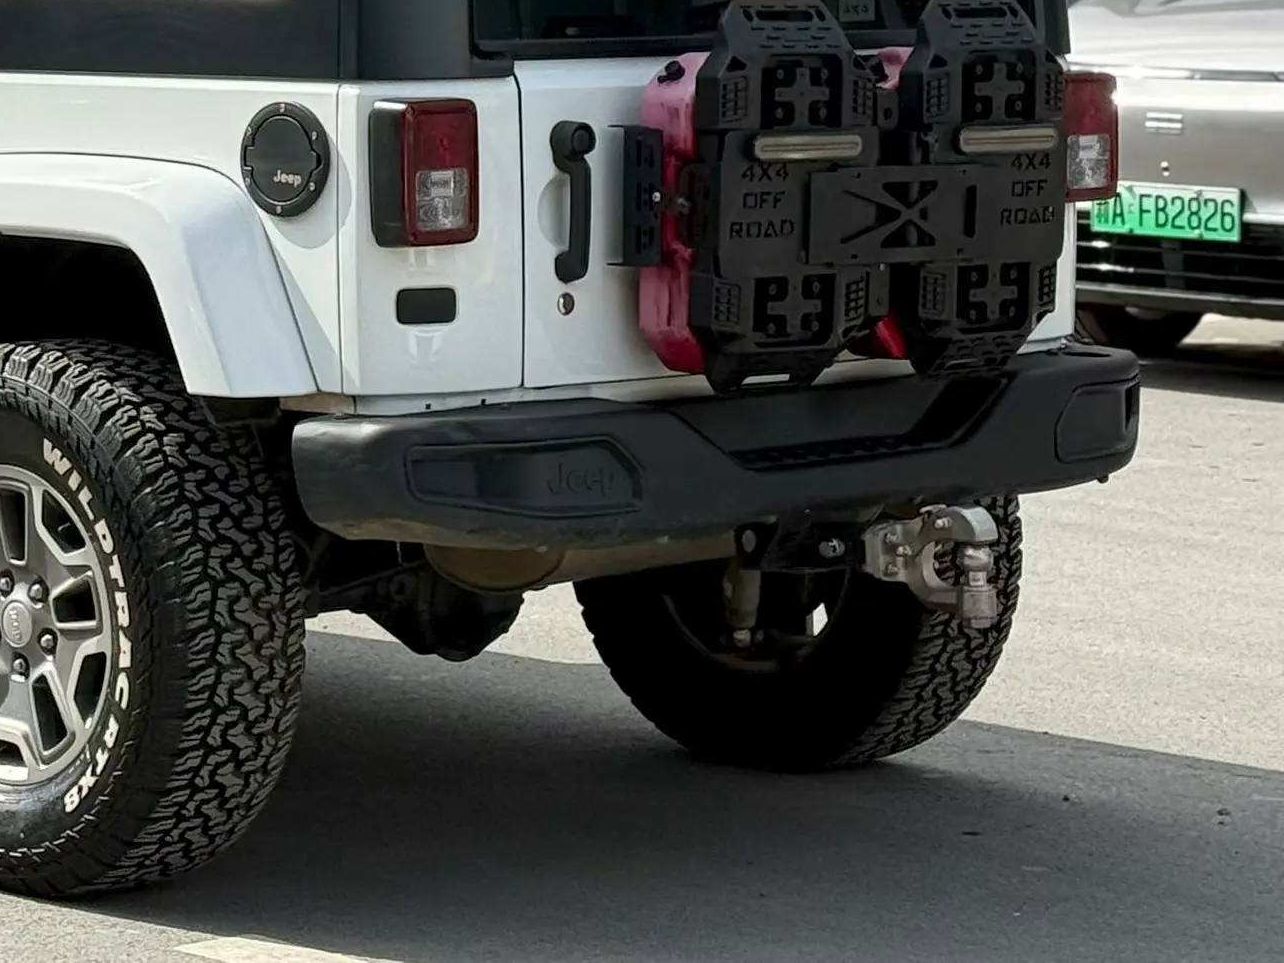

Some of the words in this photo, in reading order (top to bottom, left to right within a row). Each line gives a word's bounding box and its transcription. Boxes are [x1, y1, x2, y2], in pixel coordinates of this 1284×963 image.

[1011, 152, 1051, 170] 4X4
[272, 168, 302, 188] Jeep
[741, 161, 789, 182] 4X4
[1011, 179, 1048, 197] OFF
[742, 190, 786, 209] OFF
[1000, 205, 1056, 228] ROAD
[729, 219, 795, 239] ROAD
[42, 437, 132, 712] WILDTRAC
